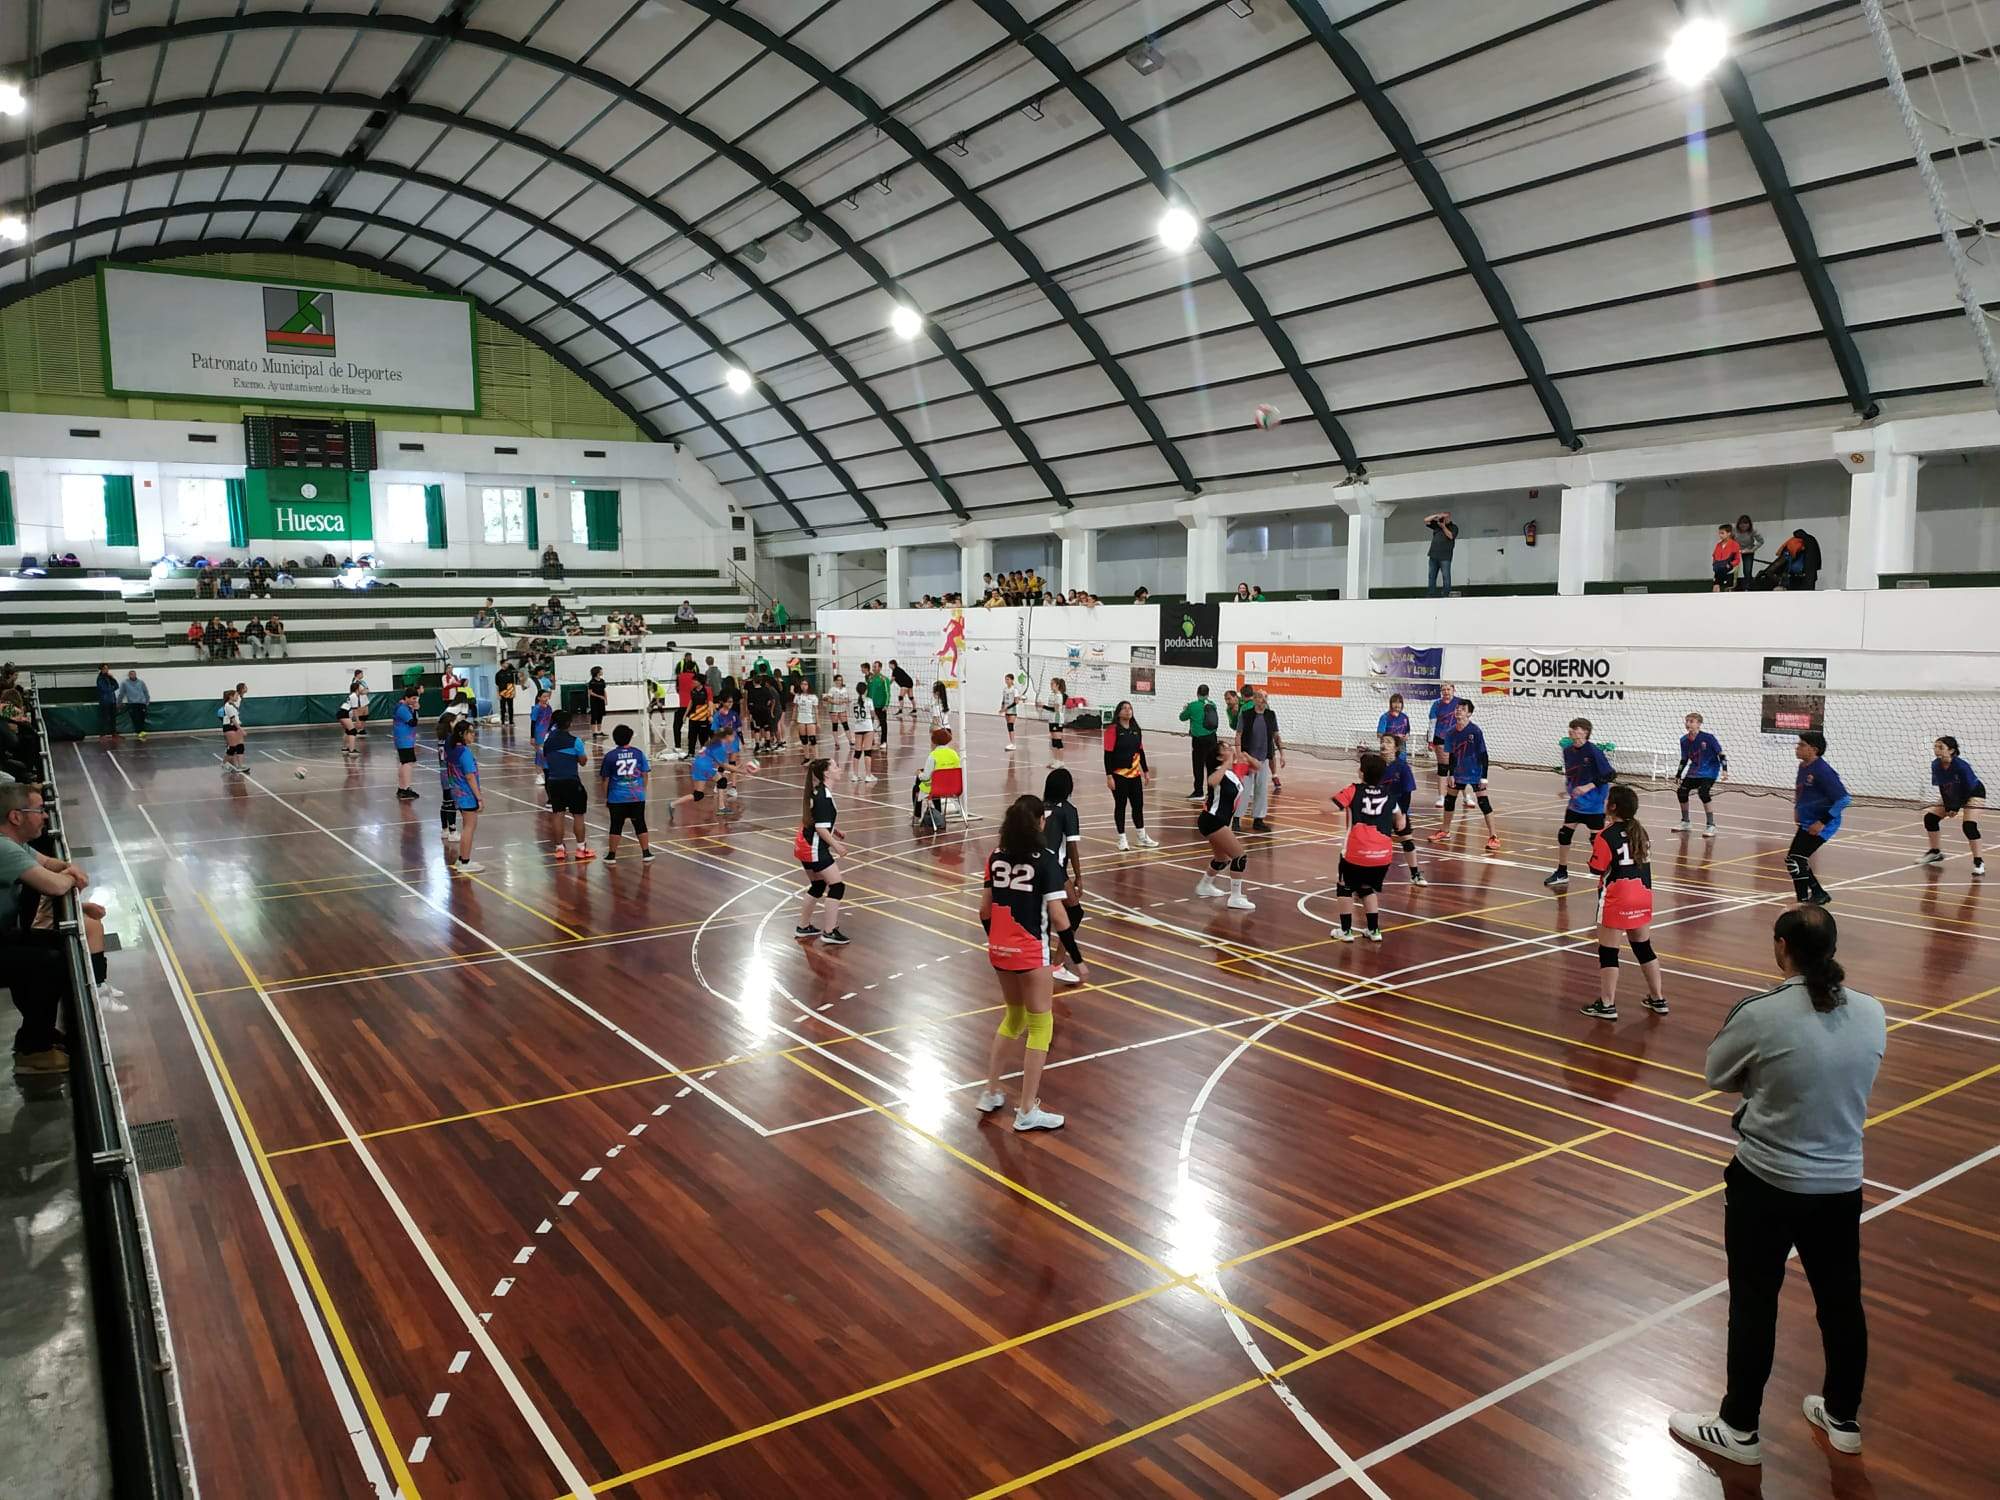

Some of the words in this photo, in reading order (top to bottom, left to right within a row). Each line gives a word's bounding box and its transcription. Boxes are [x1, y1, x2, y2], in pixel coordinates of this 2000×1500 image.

[192, 353, 258, 373] Patronato
[262, 358, 323, 379] Municipal
[329, 362, 343, 377] de
[347, 363, 403, 383] Deportes
[268, 380, 329, 393] Ayuntamiento
[330, 384, 341, 394] de
[342, 384, 372, 396] Huesca
[276, 507, 345, 532] Huesca
[1164, 636, 1213, 653] podoactiva
[1271, 652, 1333, 666] Ayuntamiento
[1512, 658, 1610, 678] GOBIERNO
[1770, 665, 1792, 675] CIUDAD
[1792, 668, 1801, 677] DE
[1801, 669, 1825, 679] HUESCA
[1512, 679, 1536, 697] DE
[853, 706, 867, 719] 56
[616, 758, 638, 776] 27
[1361, 795, 1389, 816] 17
[991, 860, 1036, 893] 32
